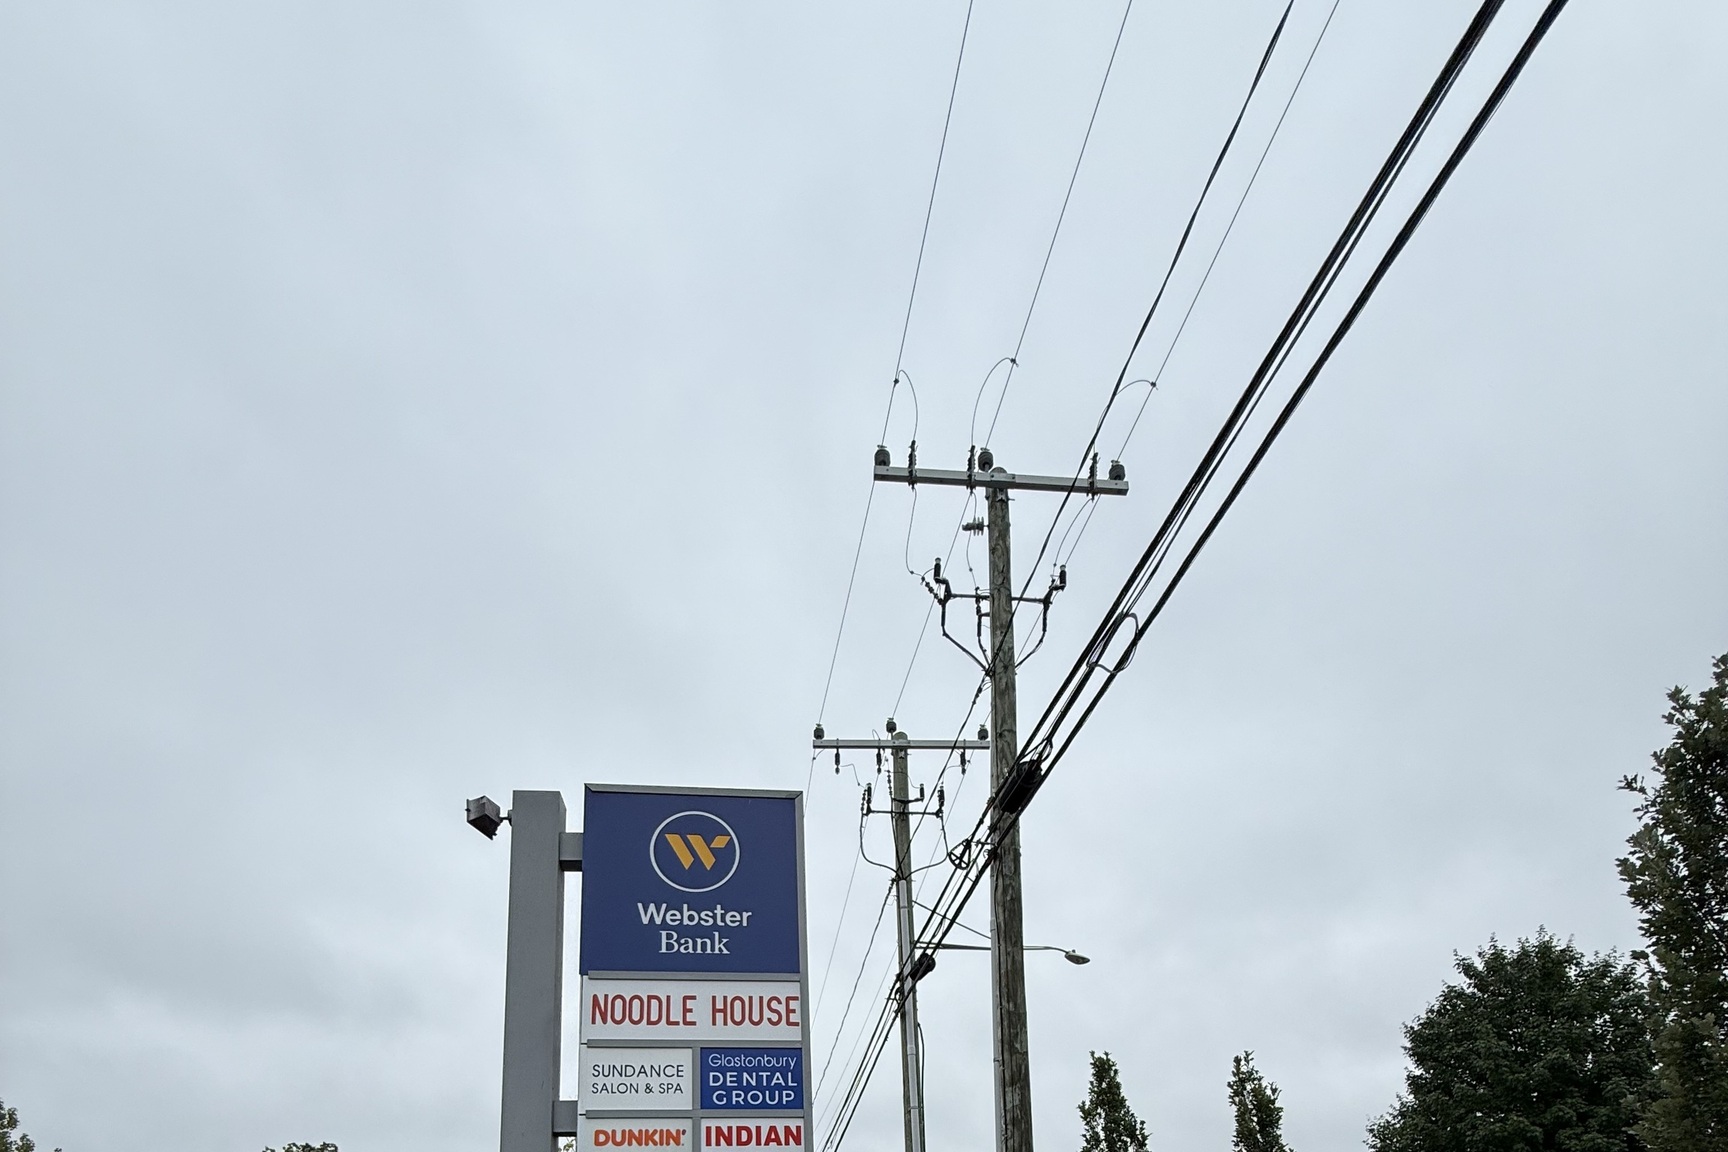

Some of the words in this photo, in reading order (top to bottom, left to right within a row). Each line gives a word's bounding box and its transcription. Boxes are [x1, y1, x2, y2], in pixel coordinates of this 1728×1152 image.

[637, 902, 753, 927] Webster
[659, 930, 731, 954] Bank
[591, 993, 698, 1026] NOODLE
[711, 995, 800, 1027] HOUSE
[708, 1053, 797, 1070] Glastonbury
[592, 1064, 684, 1078] SUNDANCE
[709, 1072, 798, 1087] DENTAL
[591, 1082, 639, 1094] SALON
[644, 1083, 654, 1094] &
[658, 1082, 684, 1094] SPA
[712, 1090, 795, 1105] GROUP
[593, 1129, 686, 1147] DUNKIN'
[705, 1125, 802, 1147] INDIAN
